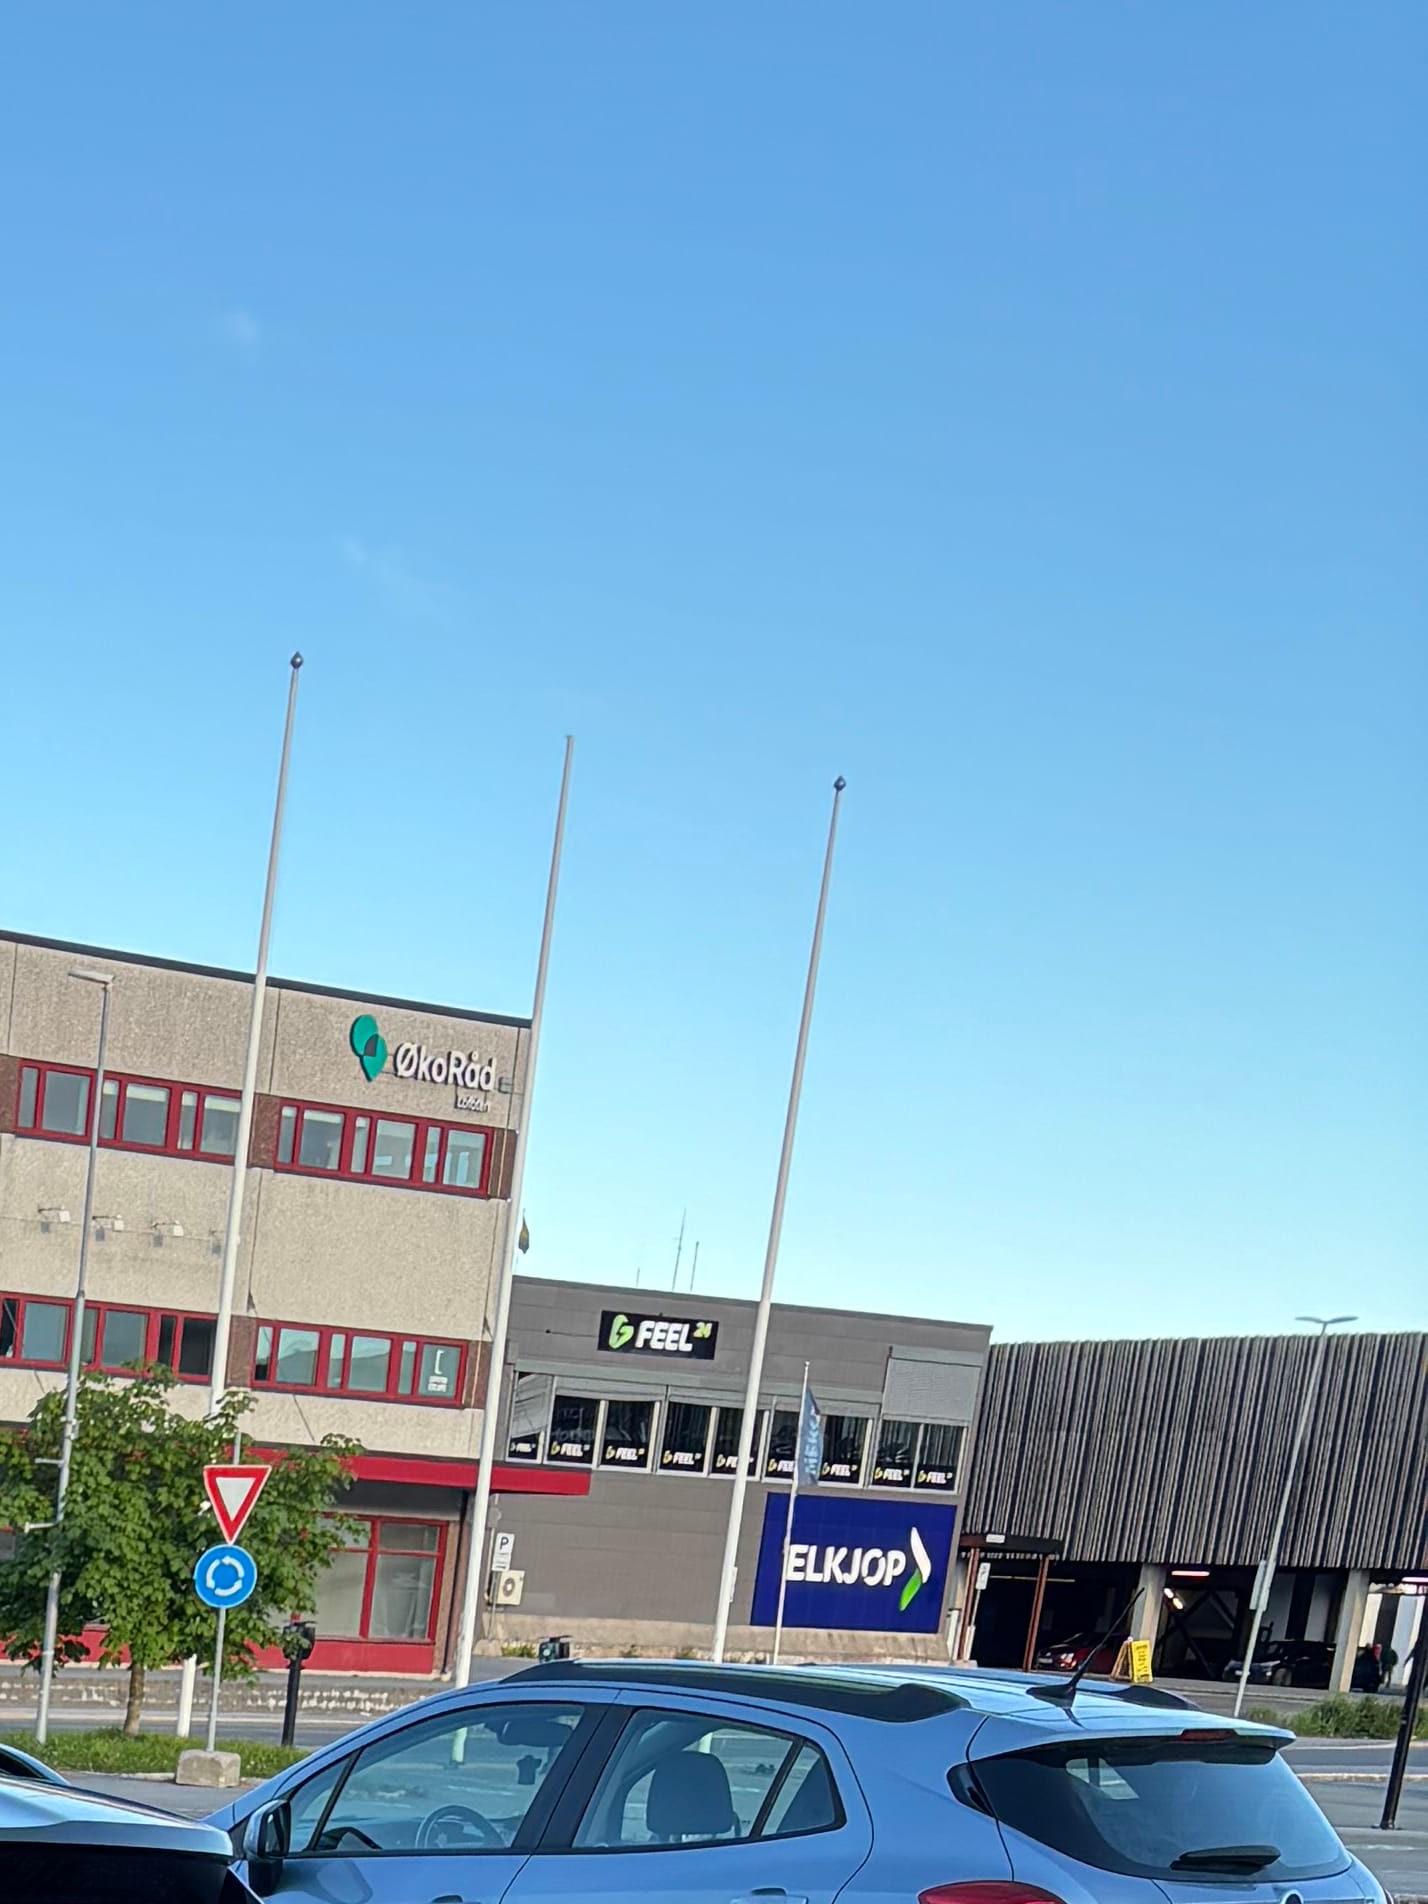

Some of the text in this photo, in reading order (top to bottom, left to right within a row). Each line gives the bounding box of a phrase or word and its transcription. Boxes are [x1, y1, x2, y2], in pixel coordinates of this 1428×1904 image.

[394, 1042, 497, 1092] ØkoRåd
[635, 1320, 713, 1352] FEEL 24
